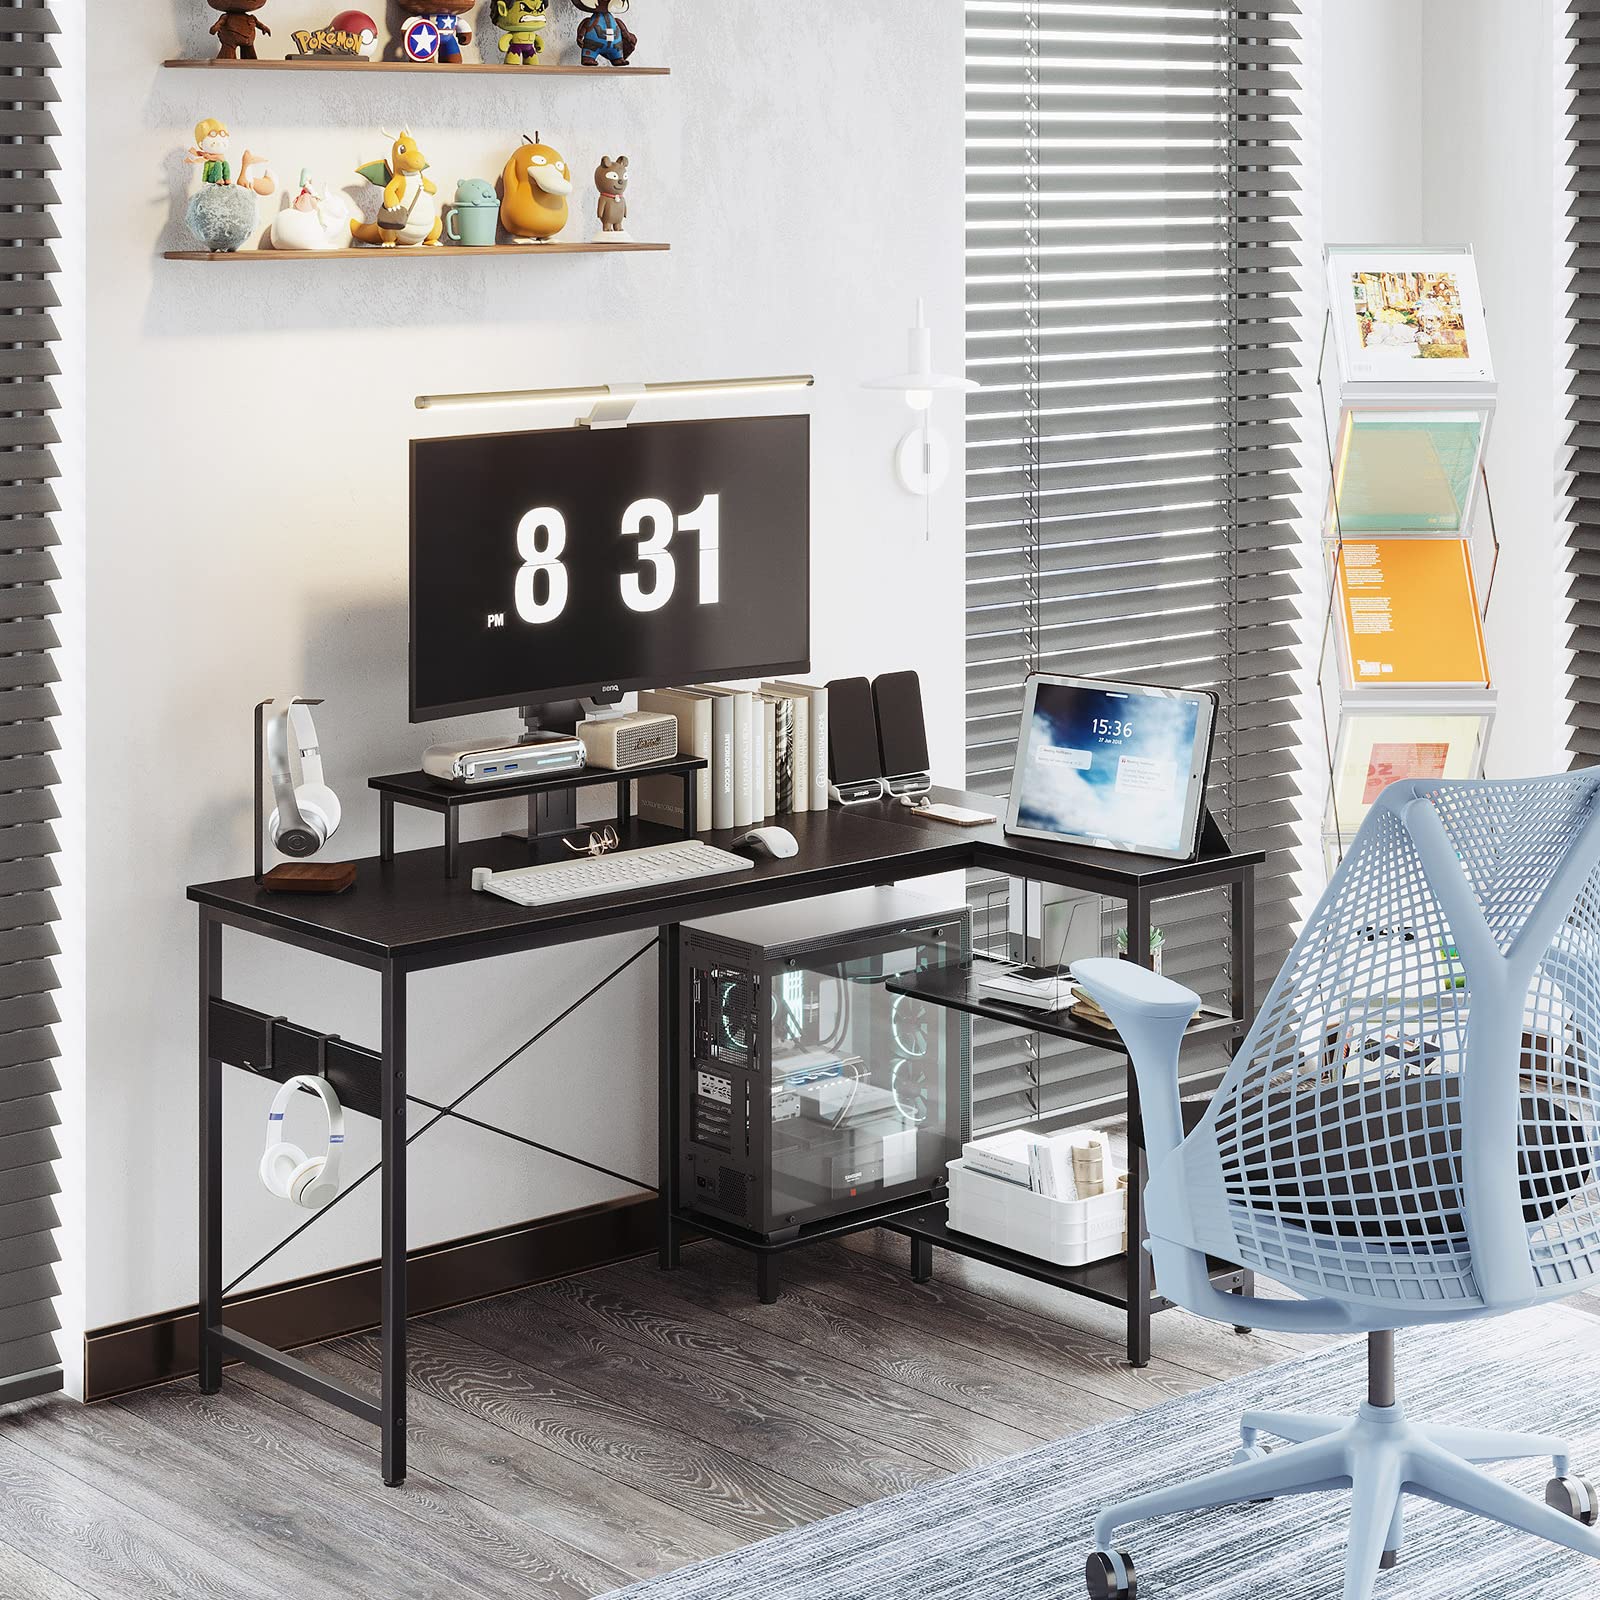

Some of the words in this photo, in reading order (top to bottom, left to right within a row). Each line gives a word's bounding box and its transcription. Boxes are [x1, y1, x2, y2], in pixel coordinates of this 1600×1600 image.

[514, 506, 568, 624] 8
[620, 493, 720, 613] 31
[487, 613, 504, 628] PM
[1092, 718, 1133, 738] 15:36
